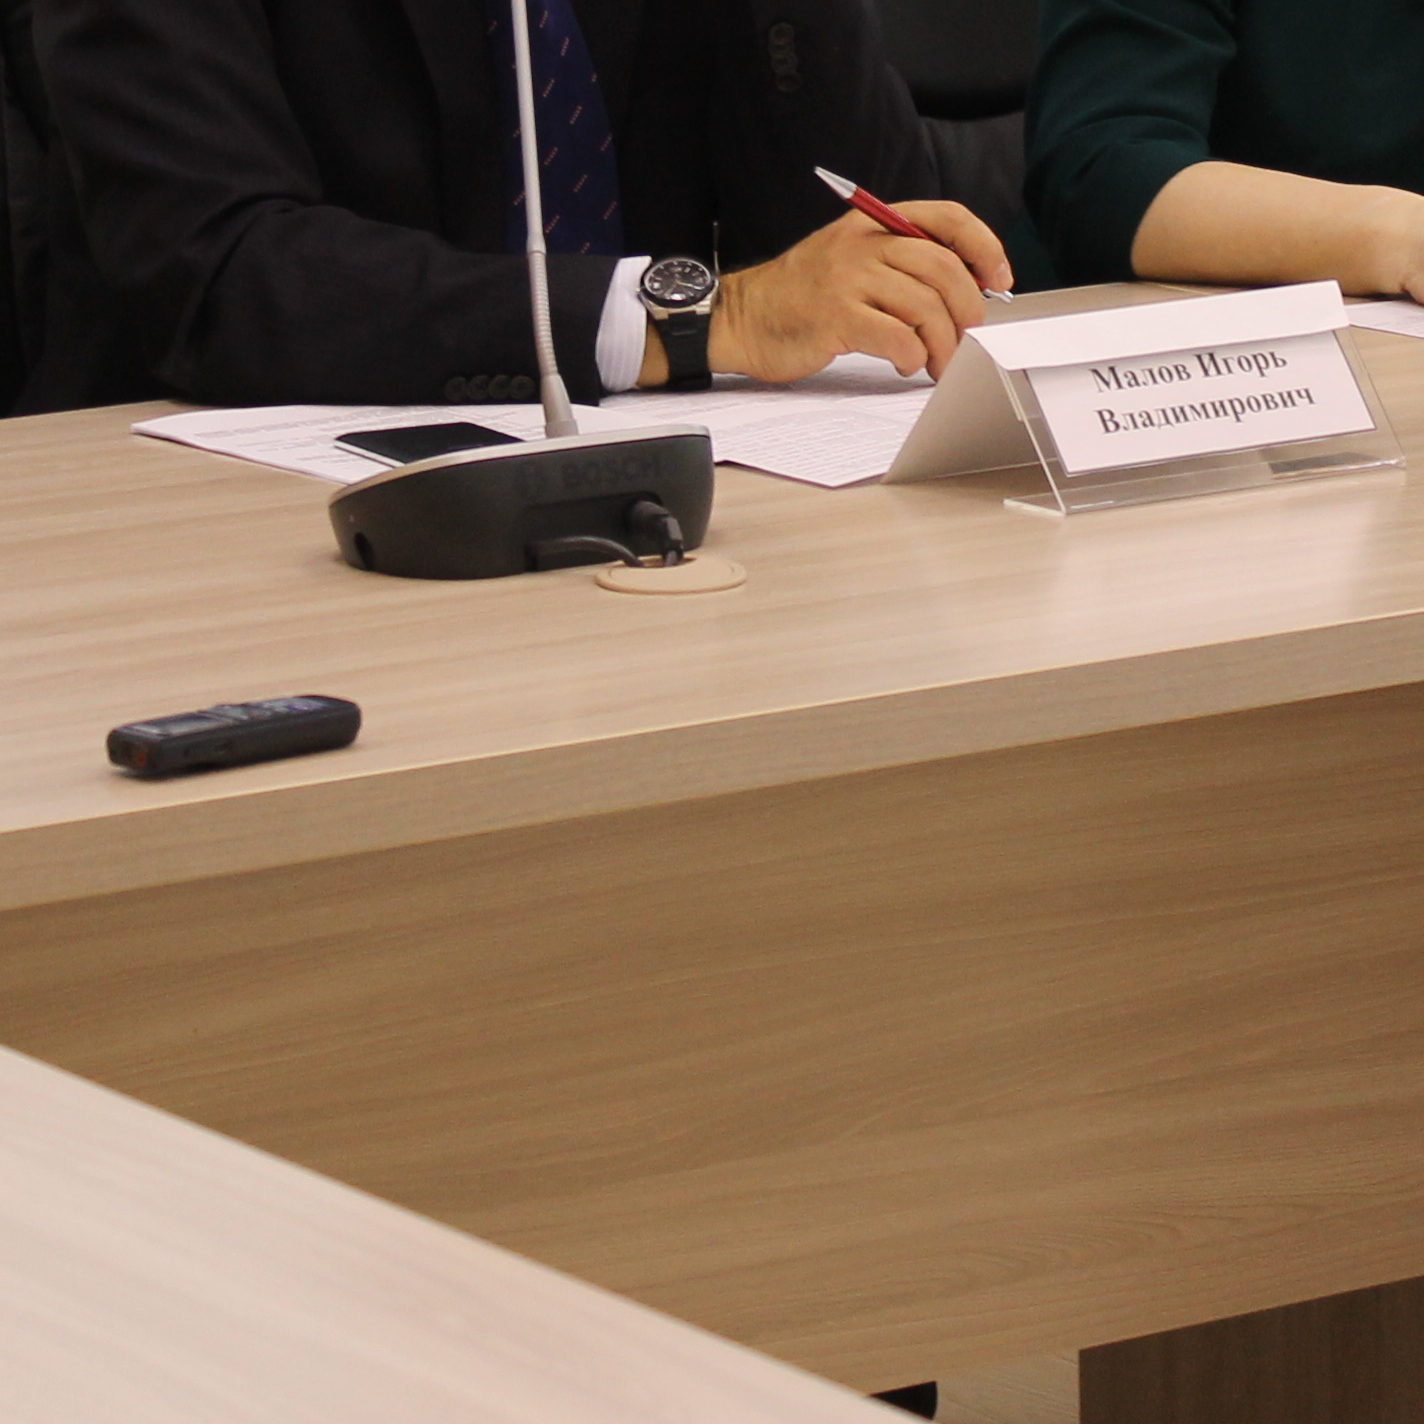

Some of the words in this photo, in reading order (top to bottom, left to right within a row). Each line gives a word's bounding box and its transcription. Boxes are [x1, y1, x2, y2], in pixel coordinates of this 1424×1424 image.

[1089, 362, 1193, 394] Малов
[1193, 350, 1288, 378] Игорь
[1094, 387, 1317, 435] Владимирович
